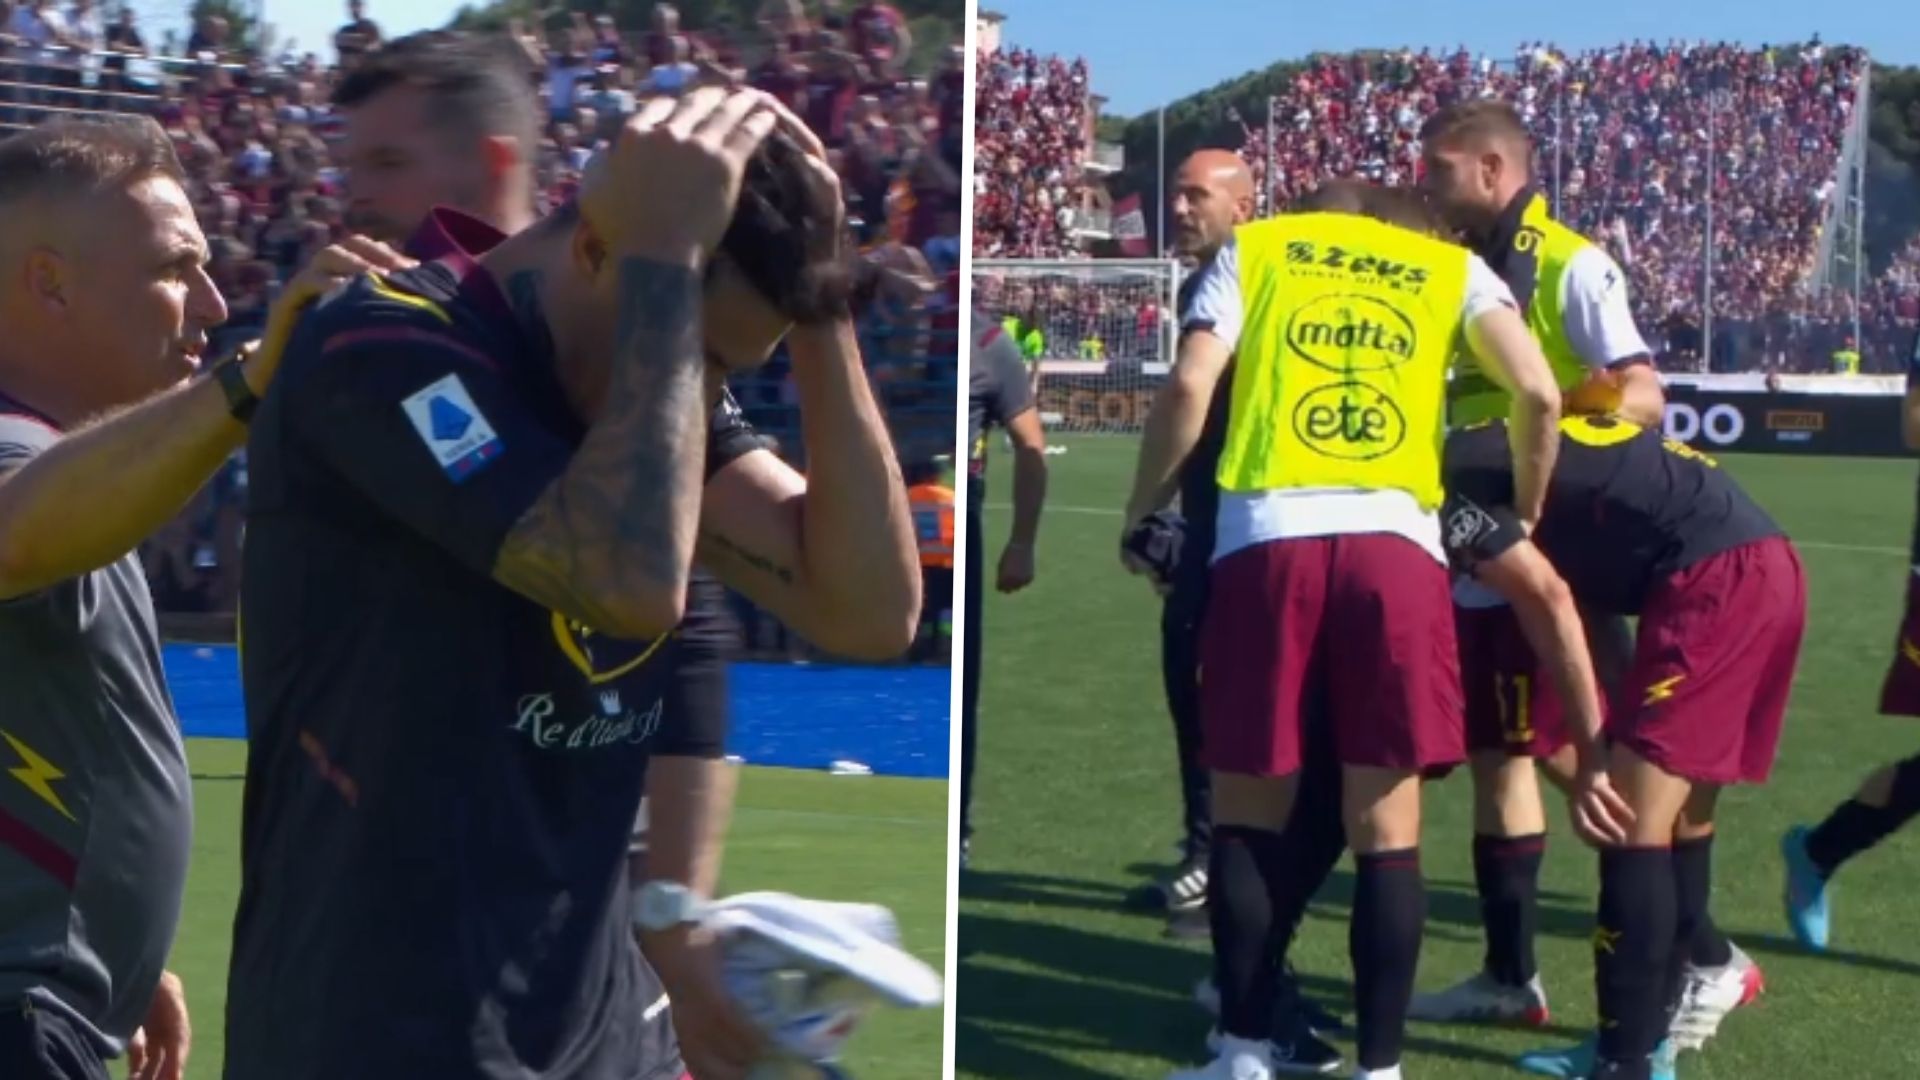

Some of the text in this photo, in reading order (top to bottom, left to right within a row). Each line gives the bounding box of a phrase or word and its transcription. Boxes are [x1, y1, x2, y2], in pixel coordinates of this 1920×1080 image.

[1300, 319, 1408, 354] matta
[1306, 393, 1387, 443] eté
[1663, 403, 1745, 443] DO
